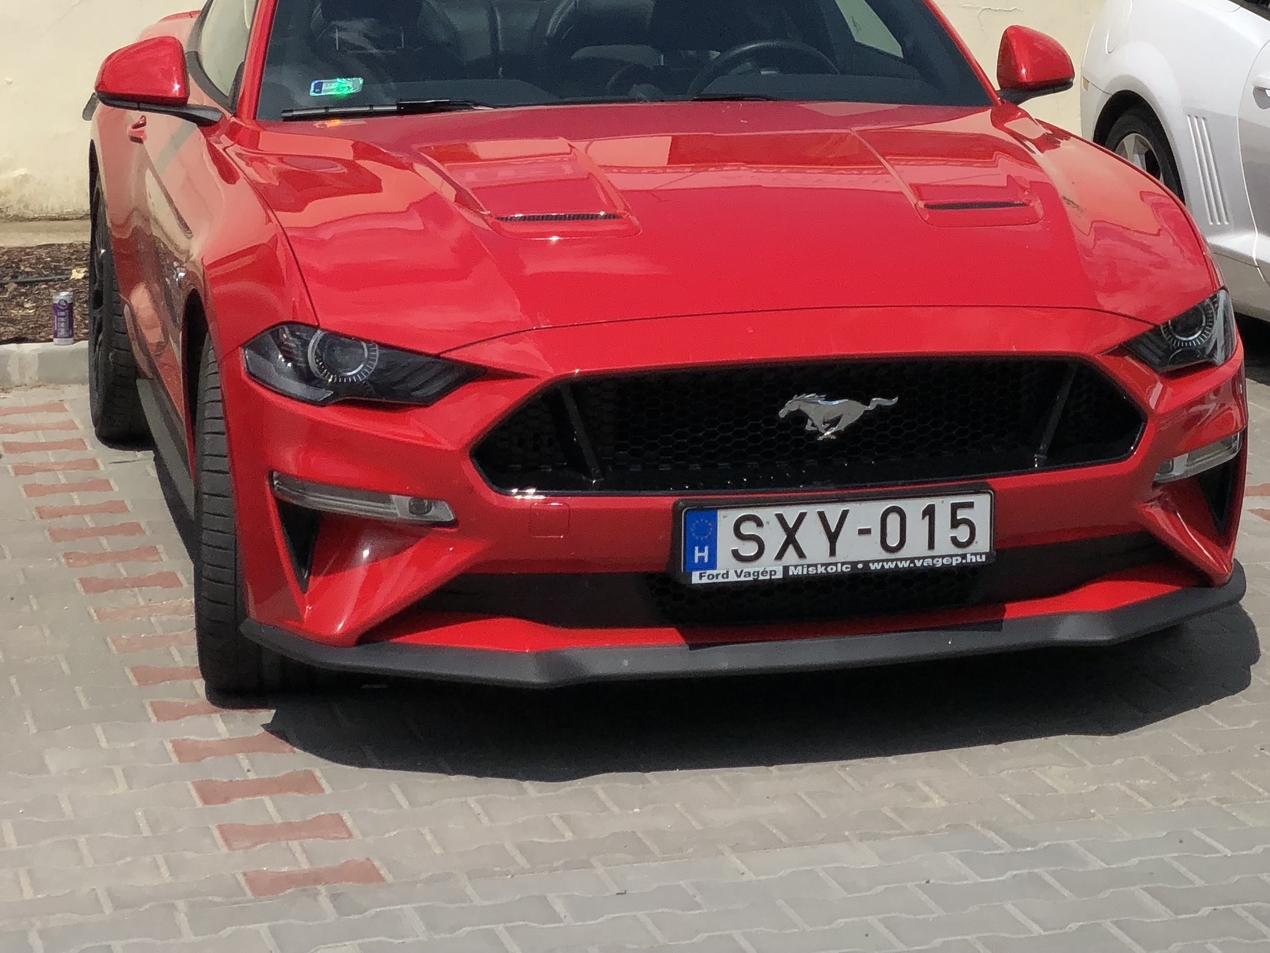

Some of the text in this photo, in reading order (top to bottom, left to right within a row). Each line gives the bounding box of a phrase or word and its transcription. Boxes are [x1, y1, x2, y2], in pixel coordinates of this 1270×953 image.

[730, 501, 977, 563] SXY-015
[694, 546, 709, 563] H
[698, 553, 986, 581] Ford Vagép Miskolc www.vagep.hu
